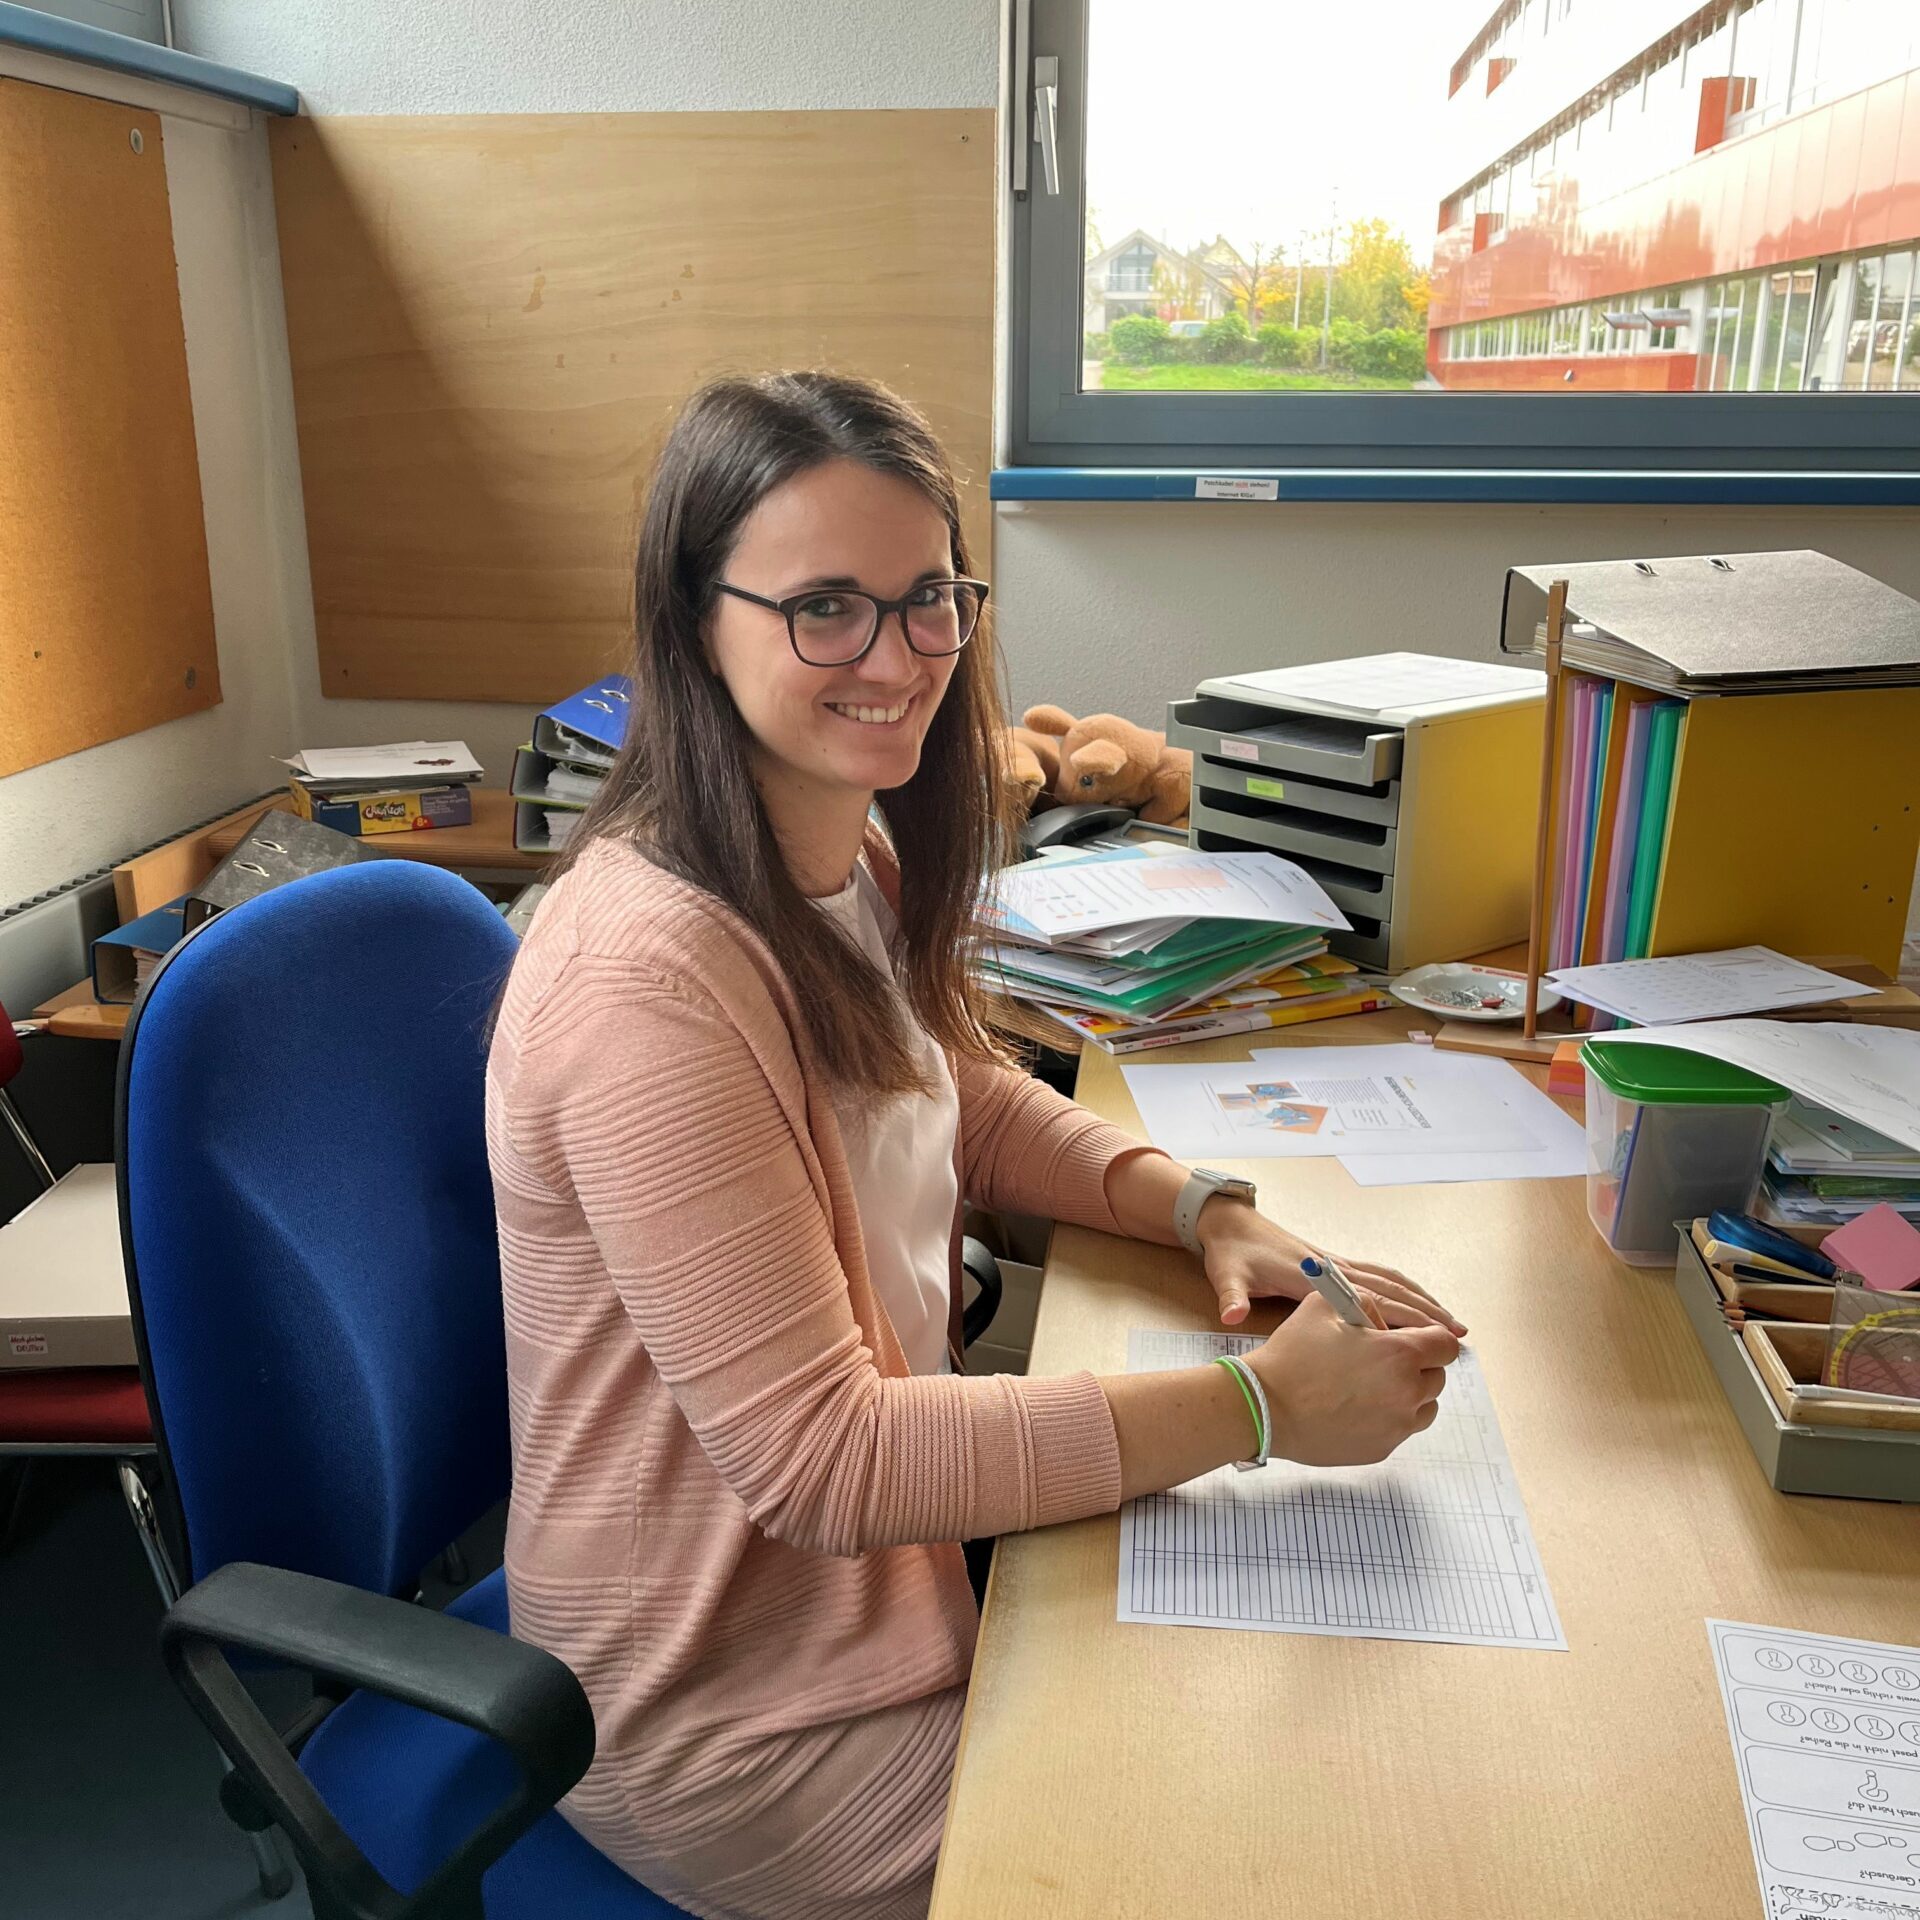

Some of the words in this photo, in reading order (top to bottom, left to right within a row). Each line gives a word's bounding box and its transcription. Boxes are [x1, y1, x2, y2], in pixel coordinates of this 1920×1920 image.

[1804, 1681, 1837, 1693] falsch?
[1840, 1686, 1861, 1695] oder
[1863, 1687, 1894, 1700] richtig
[1800, 1735, 1832, 1748] Reihe?
[1834, 1739, 1851, 1748] die
[1852, 1743, 1862, 1751] in
[1862, 1744, 1889, 1755] nicht
[1891, 1748, 1919, 1758] passt
[1848, 1801, 1865, 1810] du?
[1868, 1803, 1895, 1816] hörst
[1897, 1809, 1920, 1818] usch
[1860, 1869, 1916, 1886] Geräusch?
